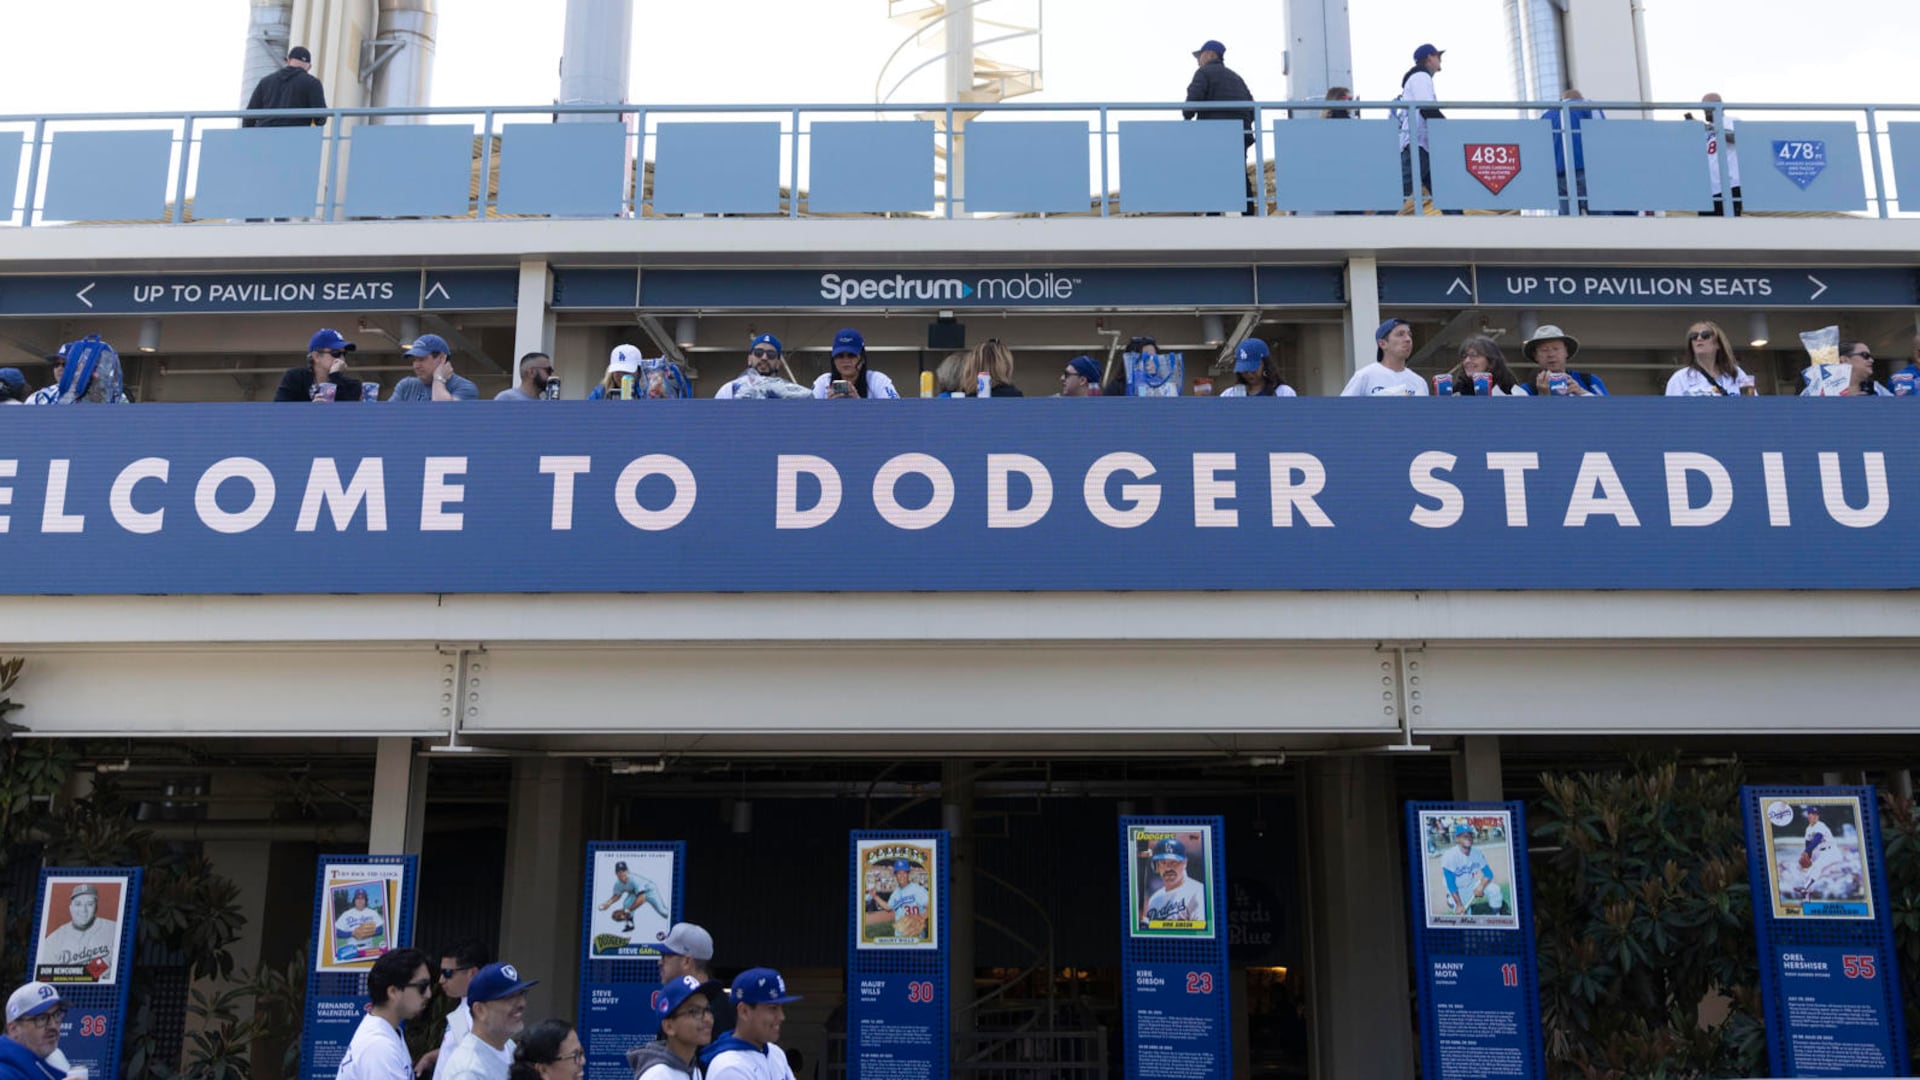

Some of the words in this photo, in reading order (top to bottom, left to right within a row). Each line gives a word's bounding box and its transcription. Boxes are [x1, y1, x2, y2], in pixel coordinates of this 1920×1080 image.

[1471, 147, 1508, 163] 483
[1779, 142, 1814, 159] 478
[133, 285, 164, 302] UP
[170, 284, 201, 302] TO
[209, 284, 316, 302] PAVILION
[322, 282, 394, 300] SEATS
[820, 273, 963, 306] Spectrum
[1506, 277, 1538, 294] UP
[1544, 277, 1577, 295] TO
[1584, 278, 1692, 296] PAVILION
[1700, 278, 1773, 296] SEATS
[539, 453, 698, 531] TO
[774, 452, 1336, 530] DODGER
[1408, 450, 1891, 529] STADIU
[1434, 962, 1464, 970] MANNY
[1502, 963, 1518, 987] 11
[1782, 953, 1804, 962] OREL
[1842, 954, 1876, 979] 55
[1784, 962, 1828, 970] HERSHISER
[908, 981, 934, 1003] 30
[1186, 971, 1214, 994] 23
[80, 1015, 107, 1037] 36
